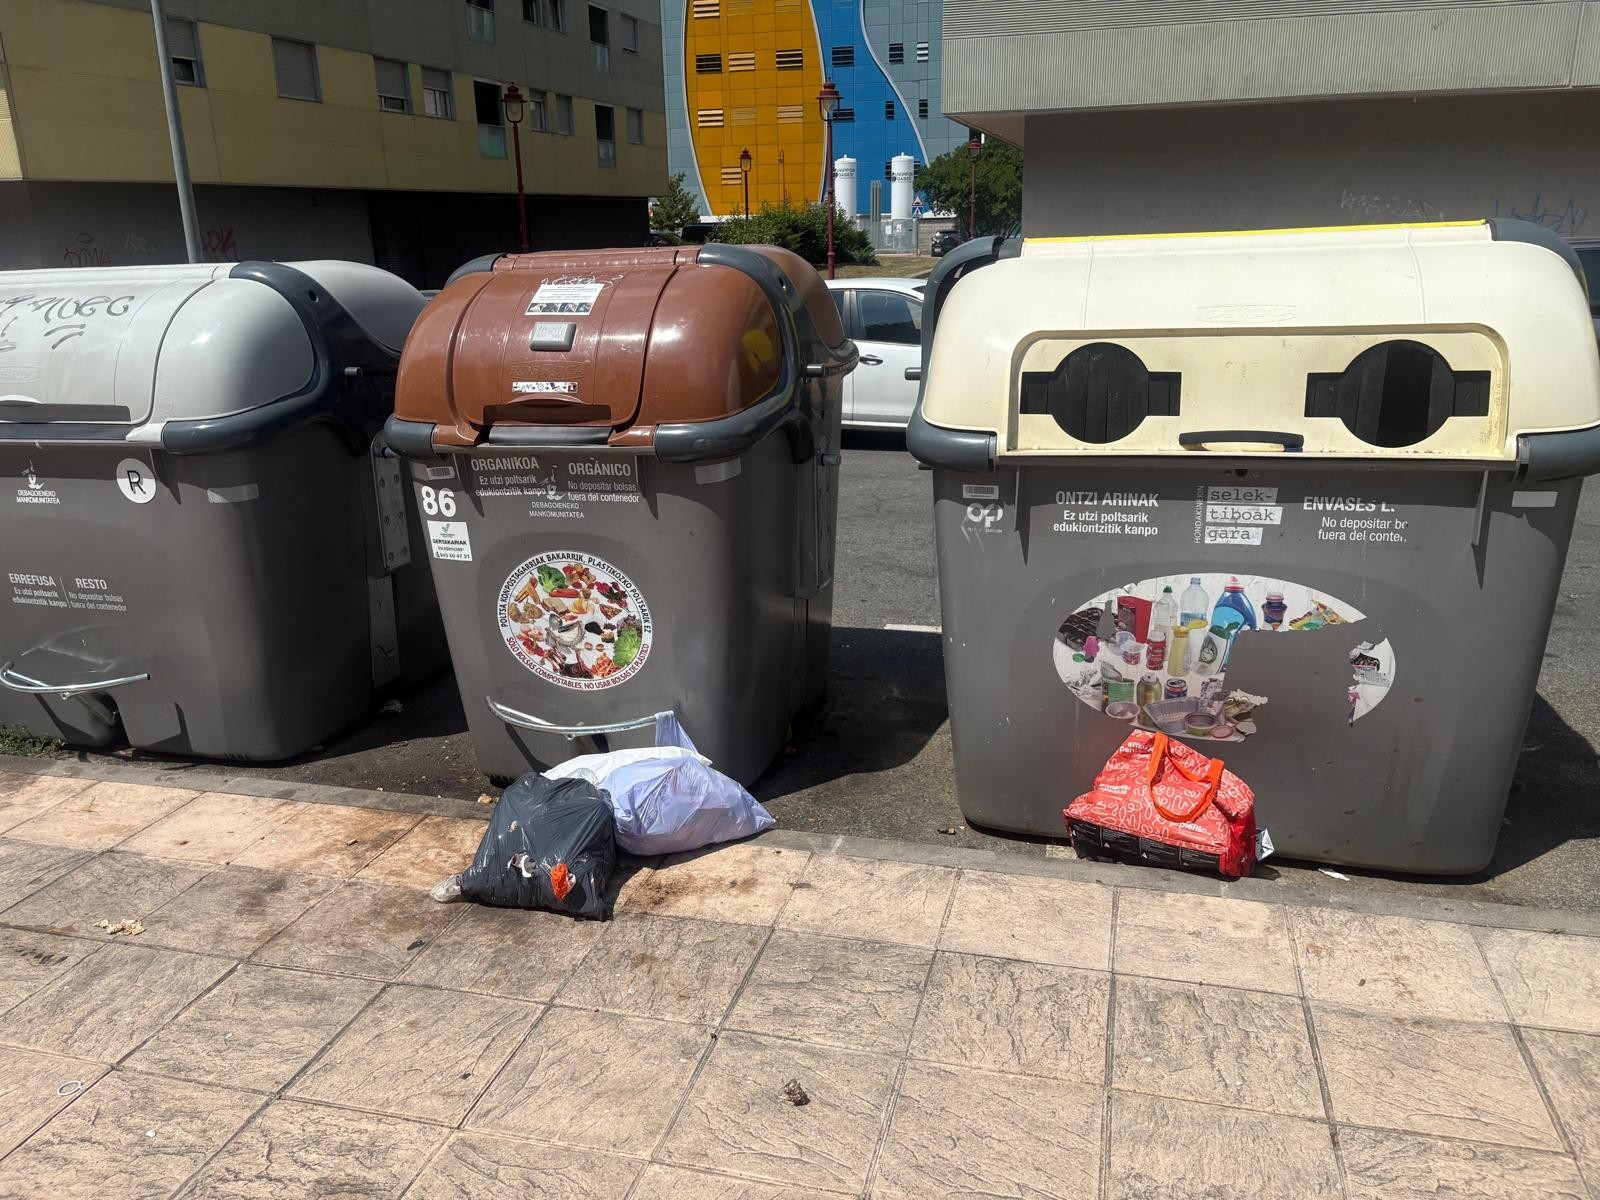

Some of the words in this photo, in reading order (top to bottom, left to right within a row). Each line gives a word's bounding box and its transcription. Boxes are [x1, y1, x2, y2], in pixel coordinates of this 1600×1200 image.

[471, 456, 540, 471] ORGANIKOA
[568, 460, 631, 476] ORGÁNICO
[127, 470, 146, 494] R
[479, 475, 489, 485] Ez
[490, 475, 503, 485] utzi
[504, 474, 538, 487] poltsarik
[568, 480, 578, 490] No
[579, 481, 612, 492] depositar
[613, 481, 637, 492] bolsas
[475, 486, 523, 497] edukiontzitik
[523, 487, 547, 498] kanpo
[568, 492, 587, 501] fuera
[588, 492, 599, 501] del
[600, 492, 640, 503] contenedor
[1055, 490, 1098, 505] ONTZI
[1101, 491, 1160, 508] ARINAK
[1210, 488, 1273, 502] selek-
[421, 485, 456, 517] 86
[531, 500, 580, 510] DEBAGOIENEKO
[1303, 496, 1376, 512] ENVASES
[529, 510, 585, 519] MANKOMUNITATEA
[1063, 509, 1076, 521] Ez
[1078, 510, 1098, 522] utzi
[1101, 510, 1149, 524] poltsarik
[1209, 506, 1275, 521] tiboak
[1053, 521, 1123, 534] edukiontzitik
[1124, 524, 1159, 537] kanpo
[1322, 516, 1337, 528] No
[1340, 517, 1392, 530] depositar
[1207, 528, 1252, 542] gara
[1318, 529, 1346, 541] fuera
[1349, 530, 1366, 542] del
[546, 552, 586, 563] BAKARRIK,
[8, 573, 56, 587] ERREFUSA
[502, 557, 546, 603] KONPOSTAGARRIAK
[588, 557, 632, 589] PLASTIKOZKO
[75, 577, 107, 590] RESTO
[630, 588, 651, 624] POLTSARIK
[499, 604, 508, 628] POLTSA
[643, 623, 652, 634] EZ
[515, 648, 536, 670] BOLSAS
[584, 680, 595, 690] NO
[594, 679, 612, 690] USAR
[611, 669, 632, 685] BOLSAS
[630, 665, 639, 676] DE
